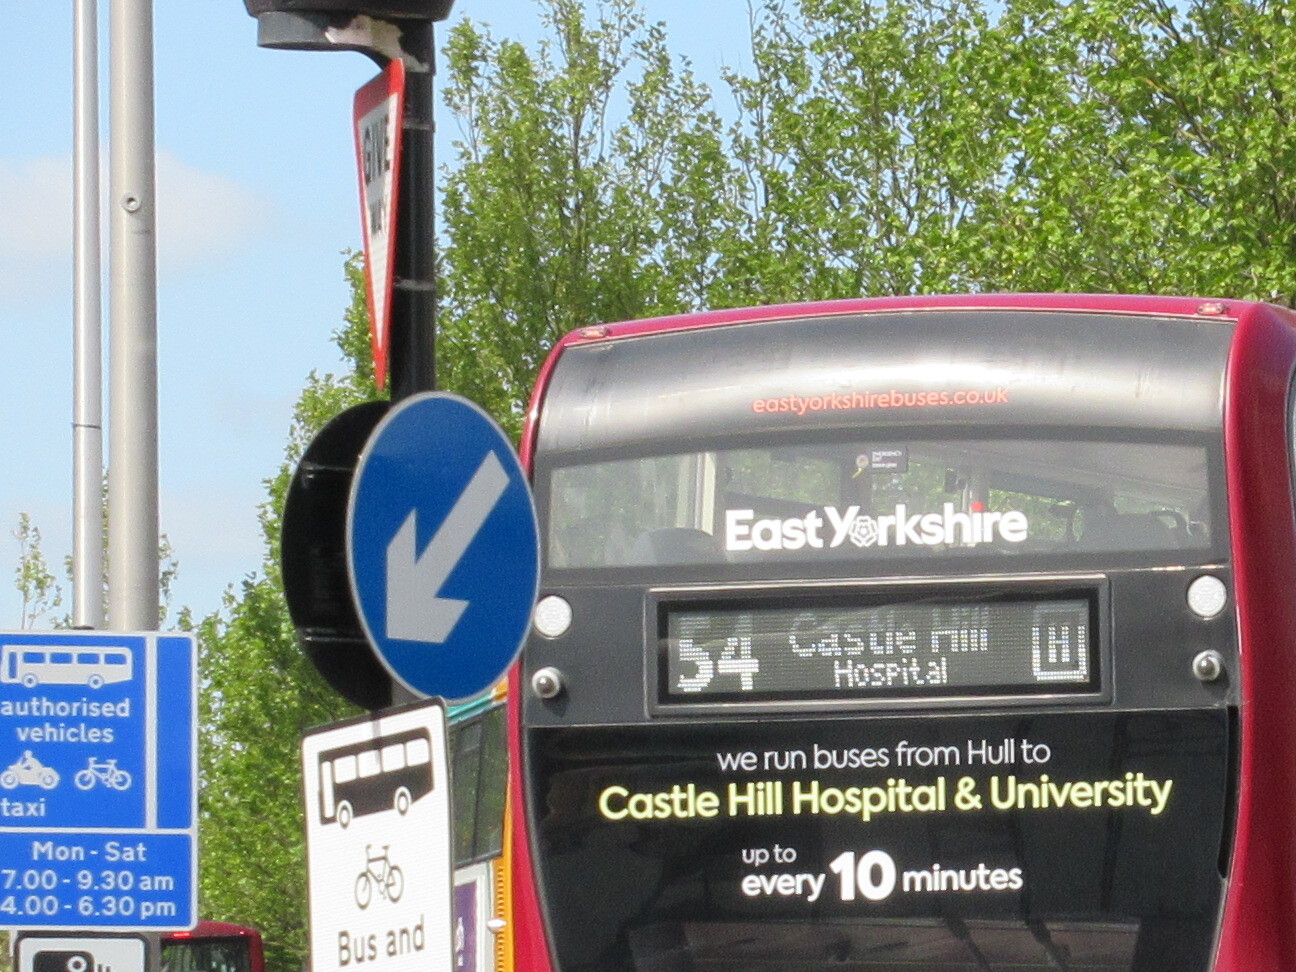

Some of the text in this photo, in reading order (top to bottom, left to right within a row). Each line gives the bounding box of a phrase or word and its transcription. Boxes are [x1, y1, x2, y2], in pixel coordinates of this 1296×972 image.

[752, 387, 1009, 415] eastyorkshirebuses.co.uk
[725, 509, 823, 551] East
[833, 656, 949, 688] Hospital
[1, 698, 130, 717] authorised
[17, 723, 115, 743] vehicles
[717, 739, 1051, 771] we run buses from Hull to
[1, 798, 46, 817] taxi
[599, 771, 1173, 822] Castle Hill Hospital & University
[32, 841, 85, 861] Mon
[104, 841, 148, 862] Sat
[741, 844, 797, 867] up to
[1, 869, 57, 890] 7.00
[77, 870, 134, 891] 9.30
[139, 875, 175, 891] am
[741, 849, 1024, 902] every 10 minutes
[0, 896, 59, 916] 4.00
[78, 896, 135, 917] 6.30
[140, 900, 177, 919] pm
[338, 914, 425, 967] Bus and
